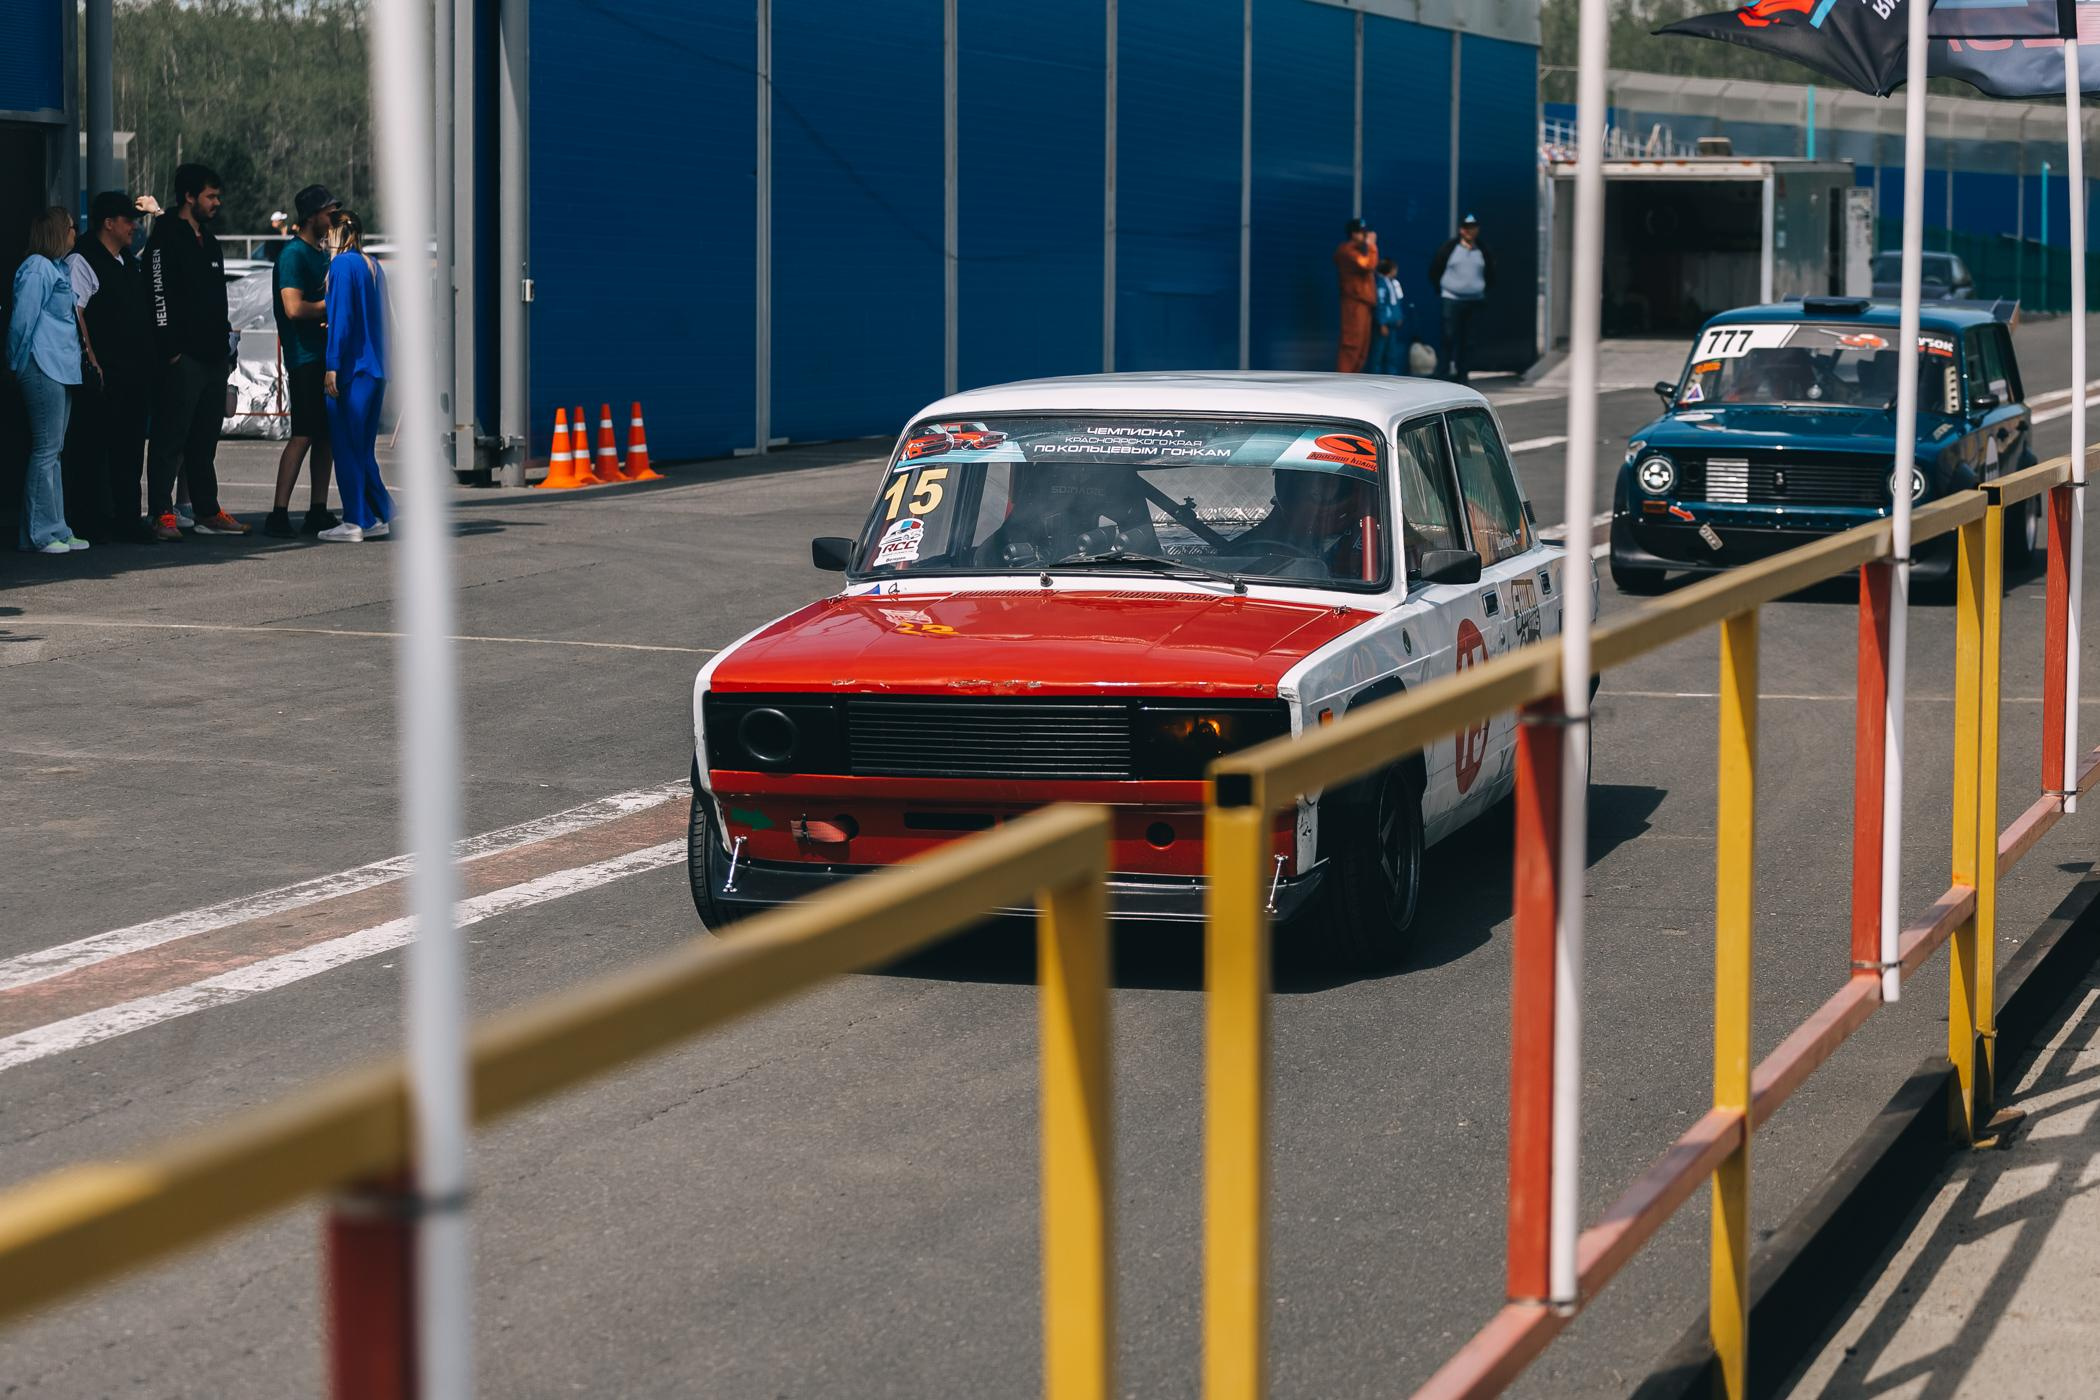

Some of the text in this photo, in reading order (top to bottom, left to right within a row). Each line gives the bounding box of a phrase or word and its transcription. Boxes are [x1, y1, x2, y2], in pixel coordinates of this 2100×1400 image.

[153, 249, 167, 326] HELLY HANSEN
[1708, 330, 1753, 354] 777
[1087, 427, 1185, 437] ЧЕМПИОНАТ
[1065, 437, 1203, 447] КРАСНОЯРСКОГО КРАЯ
[1034, 445, 1231, 457] ПО КОЛЬЦЕВЫМ ГОНКАМ
[884, 467, 949, 521] 15
[882, 540, 918, 553] RCC
